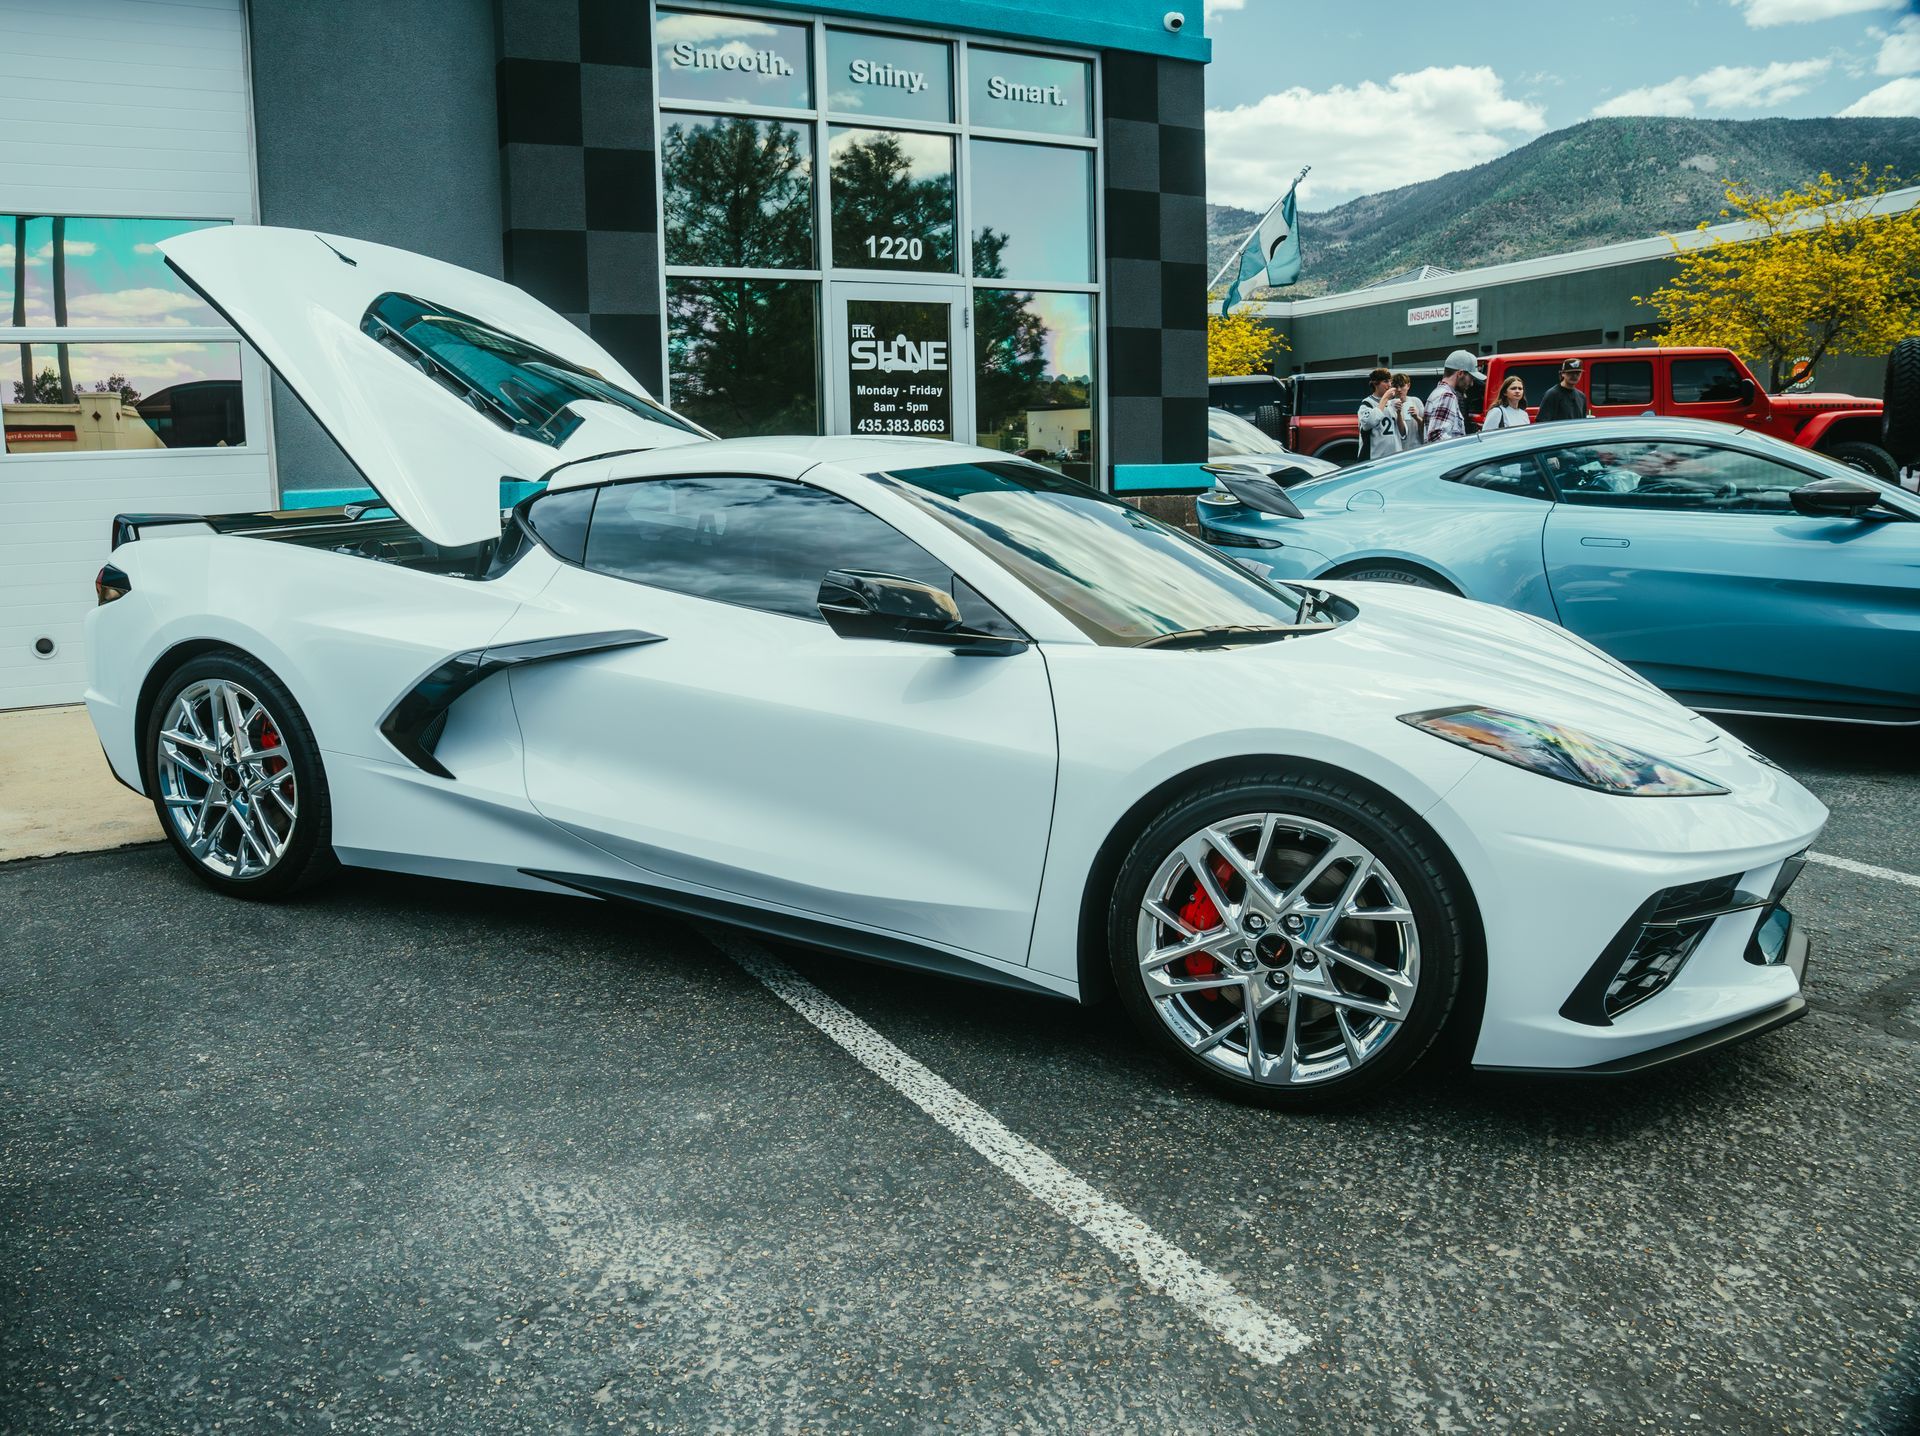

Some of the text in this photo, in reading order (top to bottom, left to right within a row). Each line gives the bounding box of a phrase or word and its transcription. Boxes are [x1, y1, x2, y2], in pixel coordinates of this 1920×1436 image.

[673, 41, 794, 77] Smooth.
[849, 59, 929, 94] Shiny.
[987, 76, 1068, 106] Smart.
[865, 235, 923, 261] 1220
[1409, 307, 1450, 322] INSURANCE
[851, 334, 948, 373] SHINE
[856, 385, 900, 398] Monday
[909, 385, 943, 398] Friday
[873, 402, 896, 412] 8am
[906, 402, 929, 414] 5pm
[857, 418, 945, 432] 435.383.8663
[1357, 572, 1417, 584] MICHELIN
[1304, 1065, 1339, 1077] FORGED
